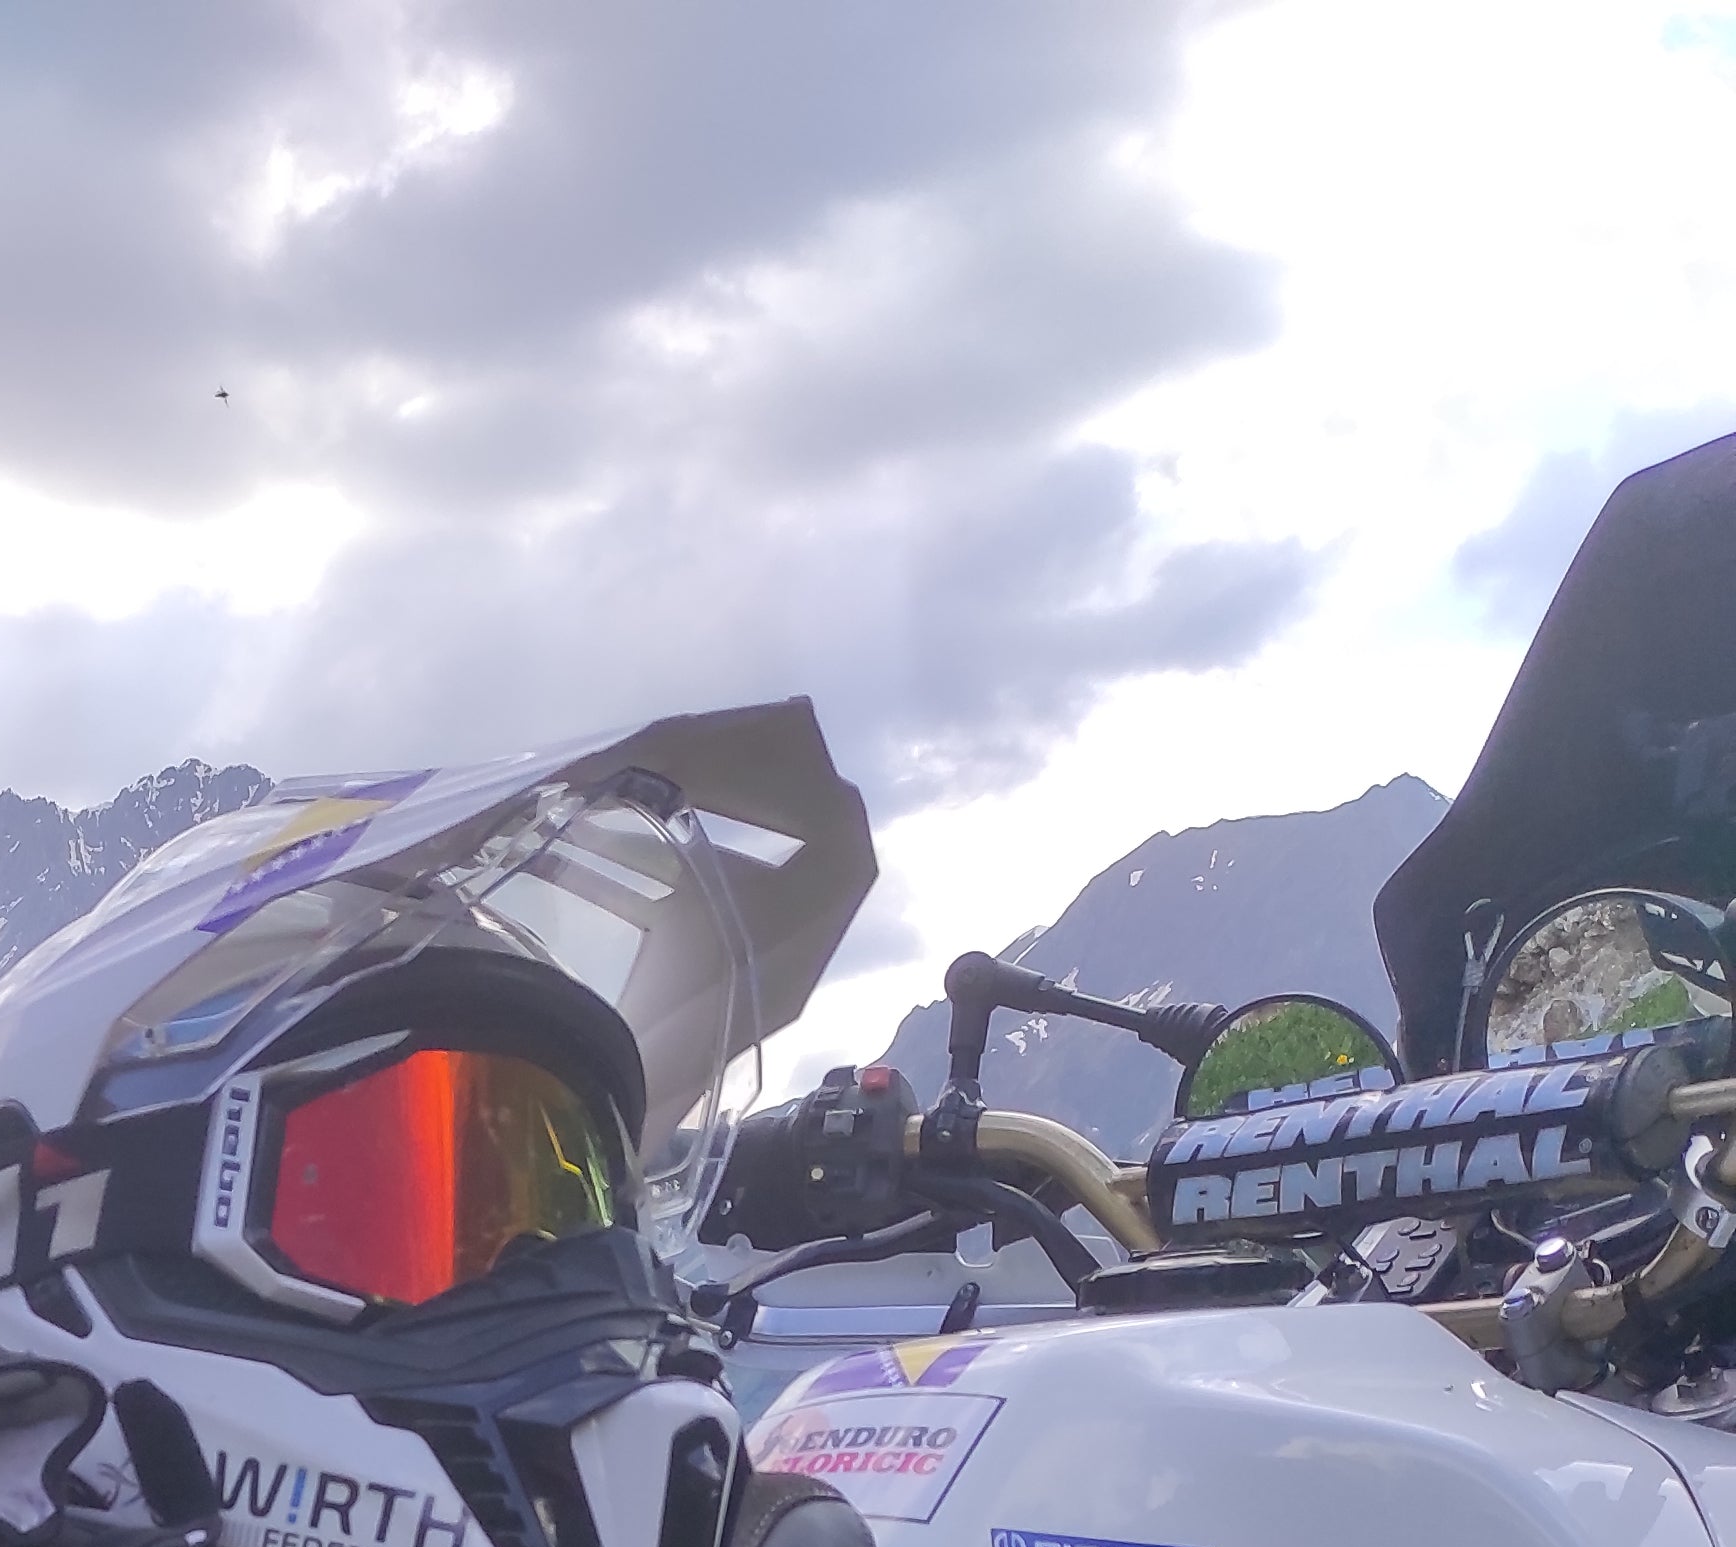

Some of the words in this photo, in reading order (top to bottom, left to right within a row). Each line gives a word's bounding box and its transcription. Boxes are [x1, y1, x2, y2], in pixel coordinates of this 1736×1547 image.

[1163, 1060, 1592, 1166] RENTHAL
[1171, 1124, 1592, 1226] RENTHAL
[797, 1426, 958, 1452] ENDURO
